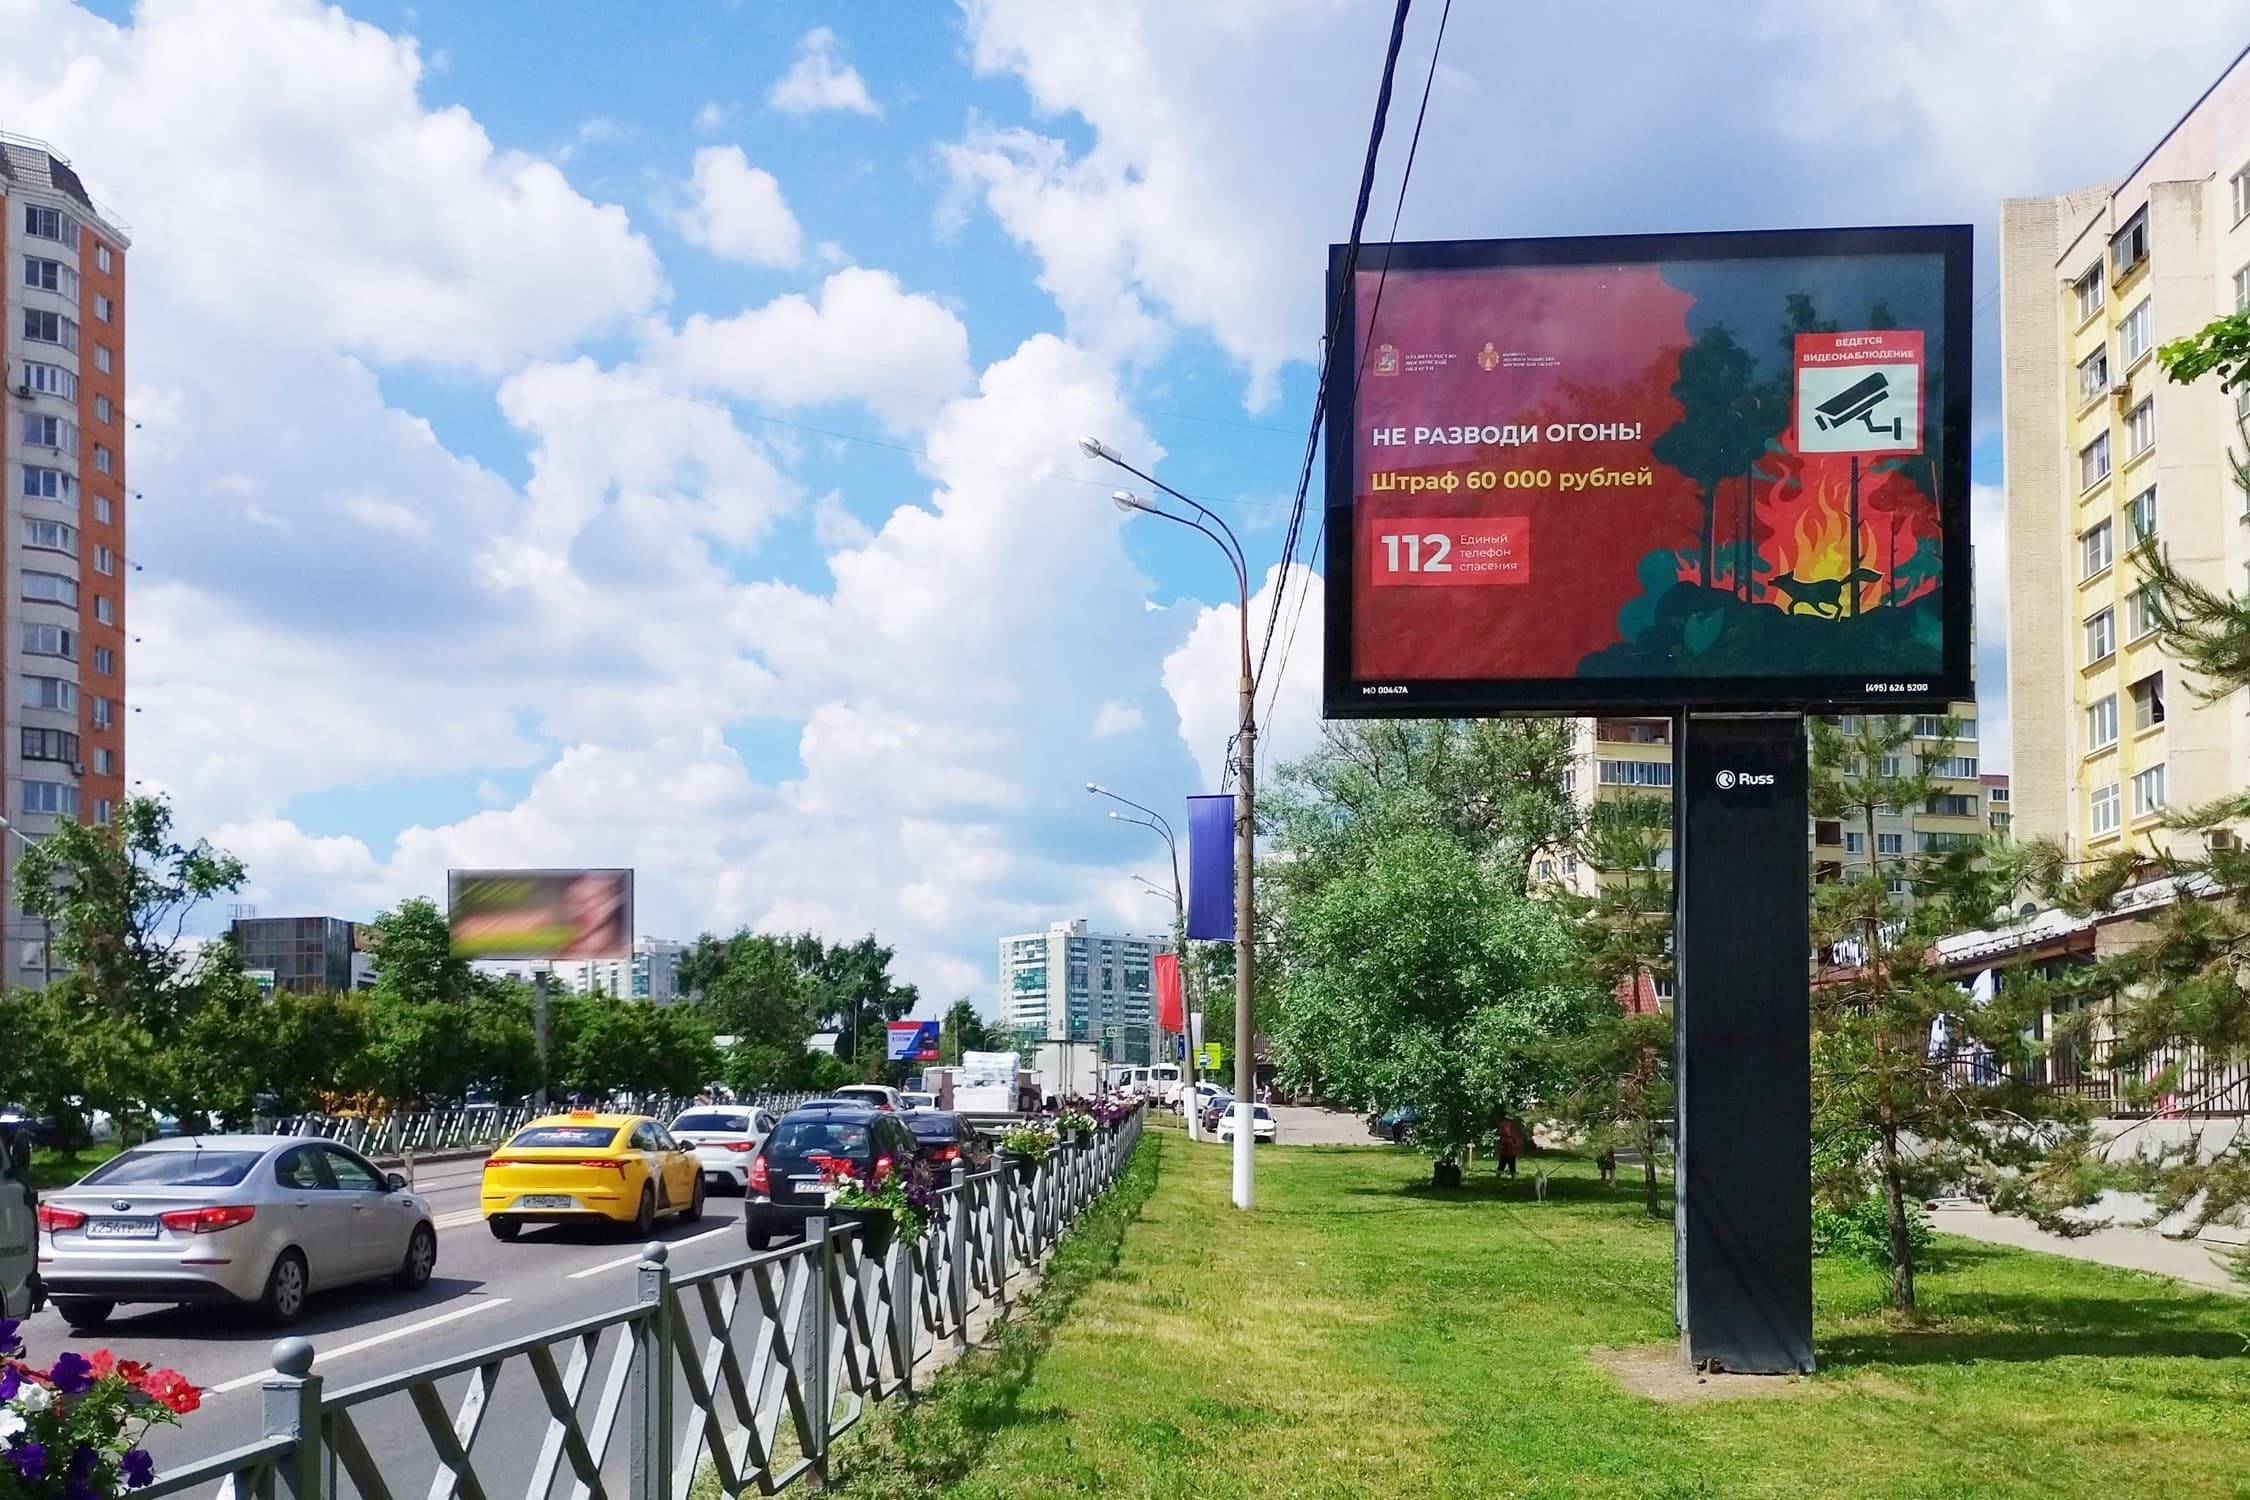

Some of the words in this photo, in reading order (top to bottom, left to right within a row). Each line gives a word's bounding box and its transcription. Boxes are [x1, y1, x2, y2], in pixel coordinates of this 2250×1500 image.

[1835, 336, 1883, 347] ВЕДЕТСЯ
[1803, 350, 1915, 362] ВИДЕОНАБЛЮДЕНИЕ
[1372, 427, 1407, 446] НЕ
[1414, 424, 1538, 447] РАЗВОДИ
[1545, 422, 1642, 442] ОГОНЬ!
[1371, 470, 1459, 495] Штраф
[1466, 471, 1497, 489] 60
[1503, 469, 1551, 489] 000
[1559, 466, 1653, 492] рублей
[1460, 533, 1508, 545] Единый
[1380, 534, 1452, 573] 112
[1460, 547, 1511, 560] телефон
[1459, 560, 1518, 572] спасения
[1865, 682, 1887, 693] (495)
[1889, 683, 1905, 692] 626
[1906, 683, 1928, 692] 5200
[1739, 773, 1775, 785] Russ
